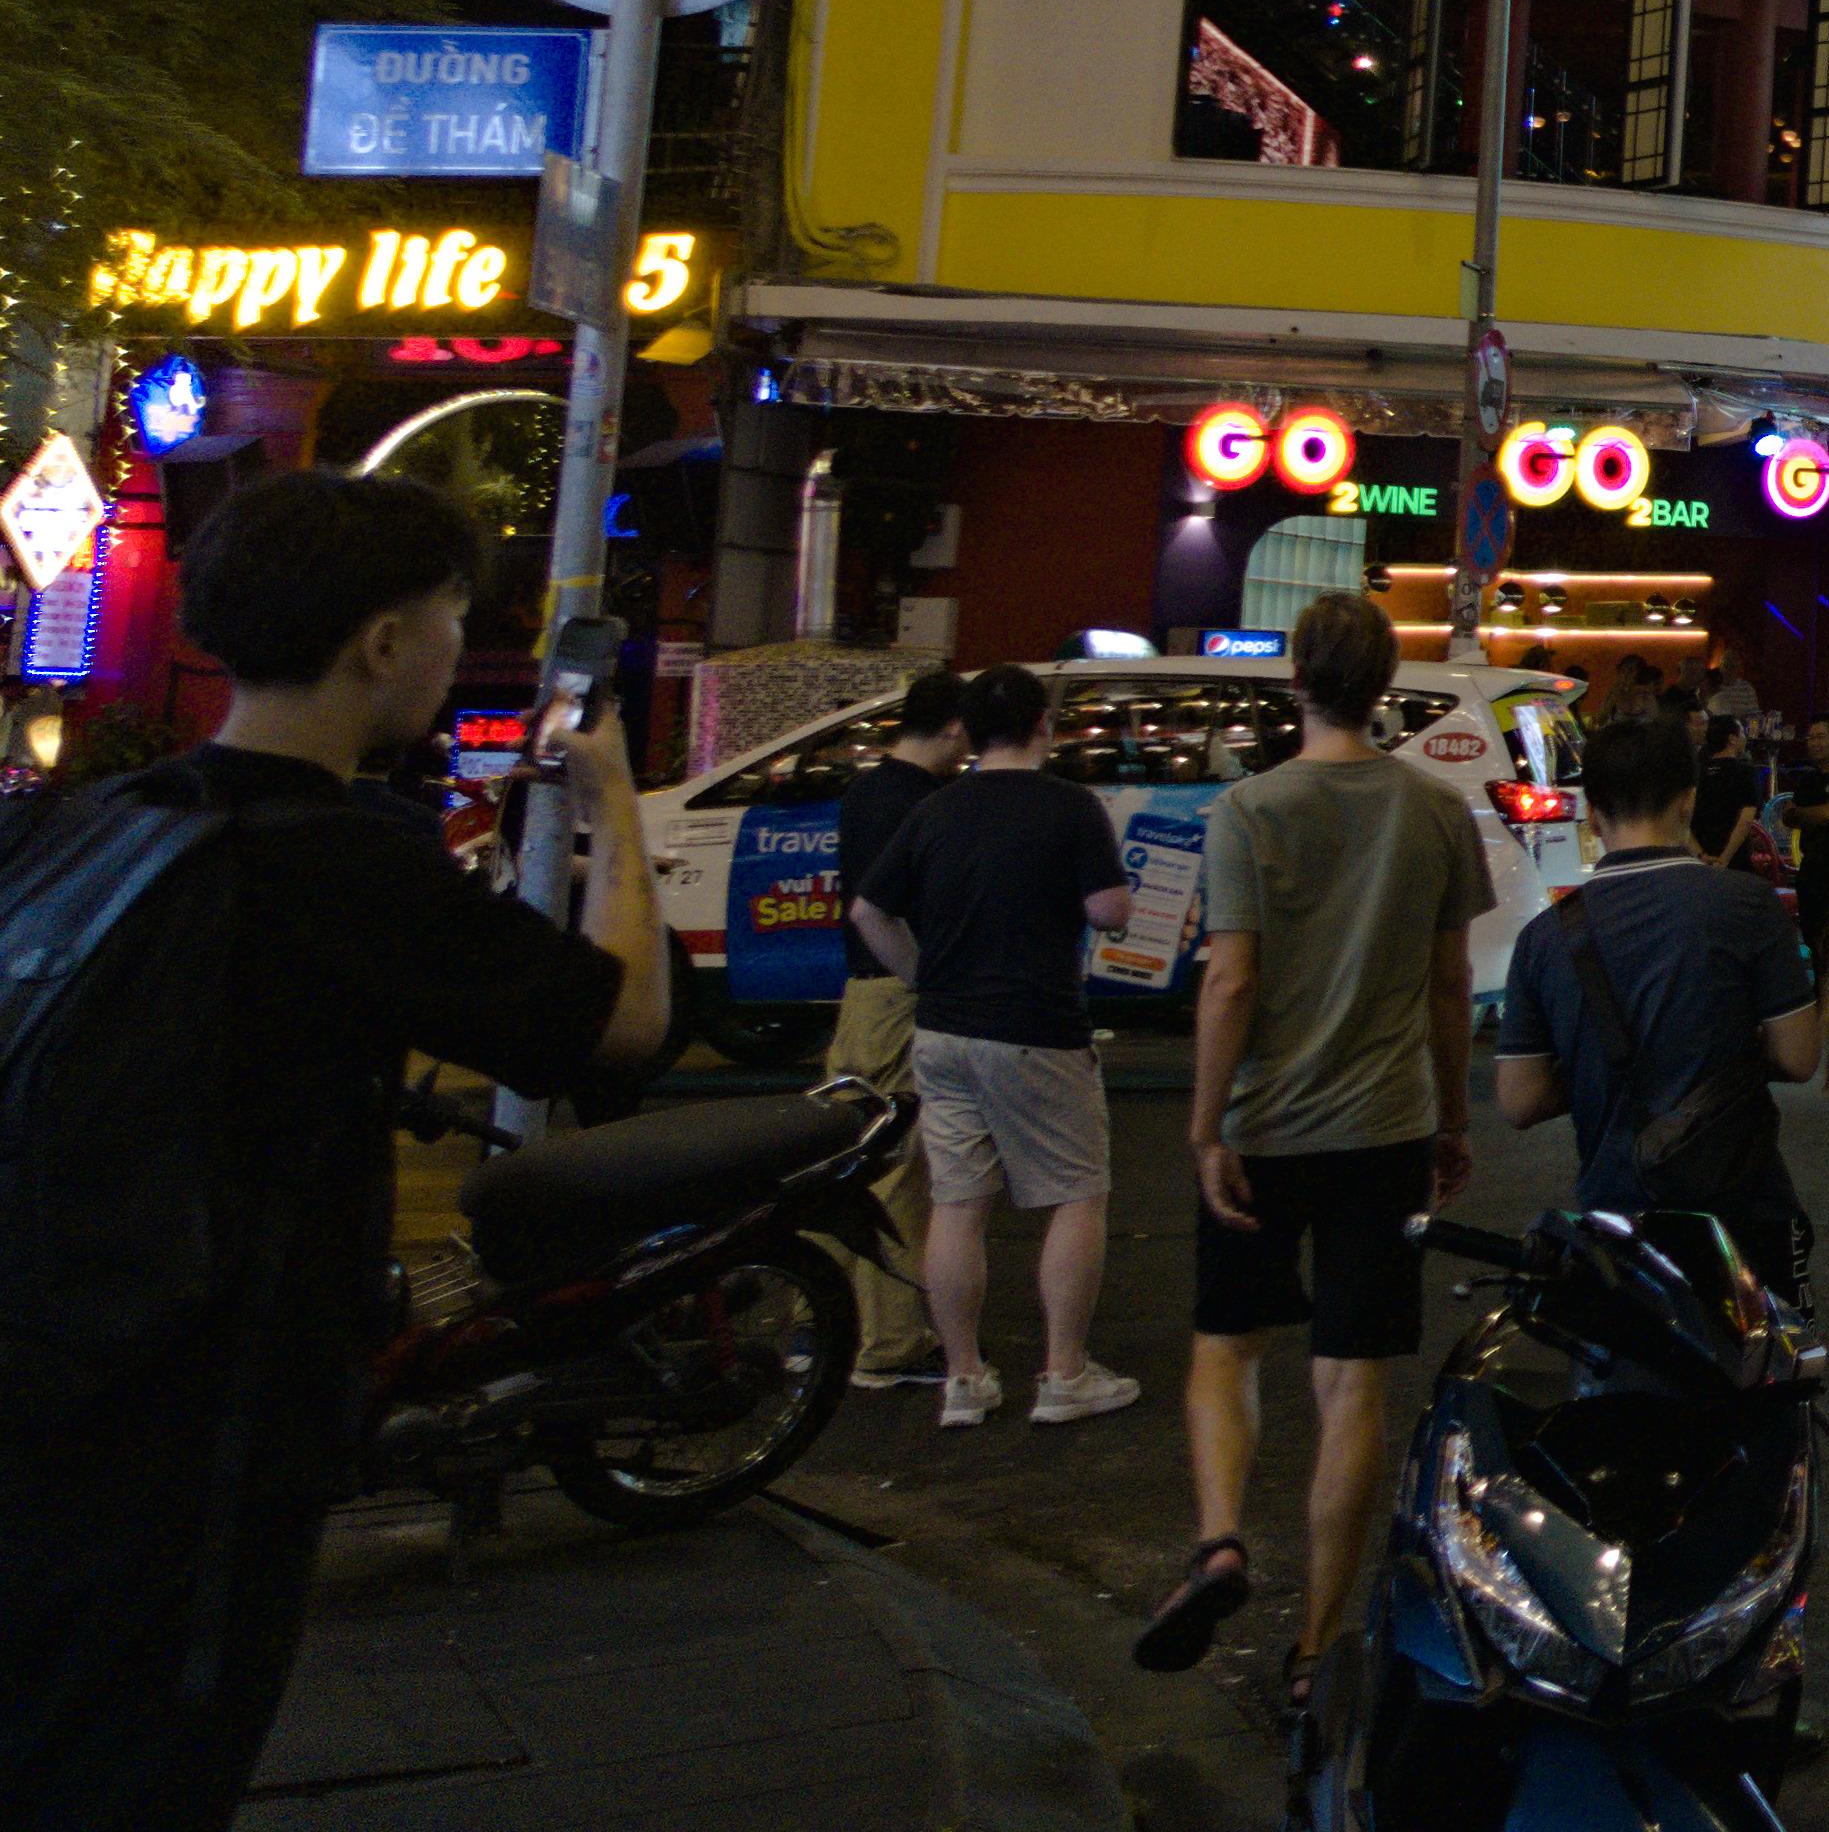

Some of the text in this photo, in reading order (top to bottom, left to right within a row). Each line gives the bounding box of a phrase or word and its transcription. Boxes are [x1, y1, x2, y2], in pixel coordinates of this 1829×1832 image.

[423, 103, 548, 156] THÁM
[357, 228, 508, 312] life
[624, 231, 697, 315] 5
[1184, 403, 1357, 495] GO
[1499, 422, 1650, 510] GO
[1231, 638, 1281, 658] pepsi
[778, 874, 814, 894] vui
[758, 897, 830, 926] Sale
